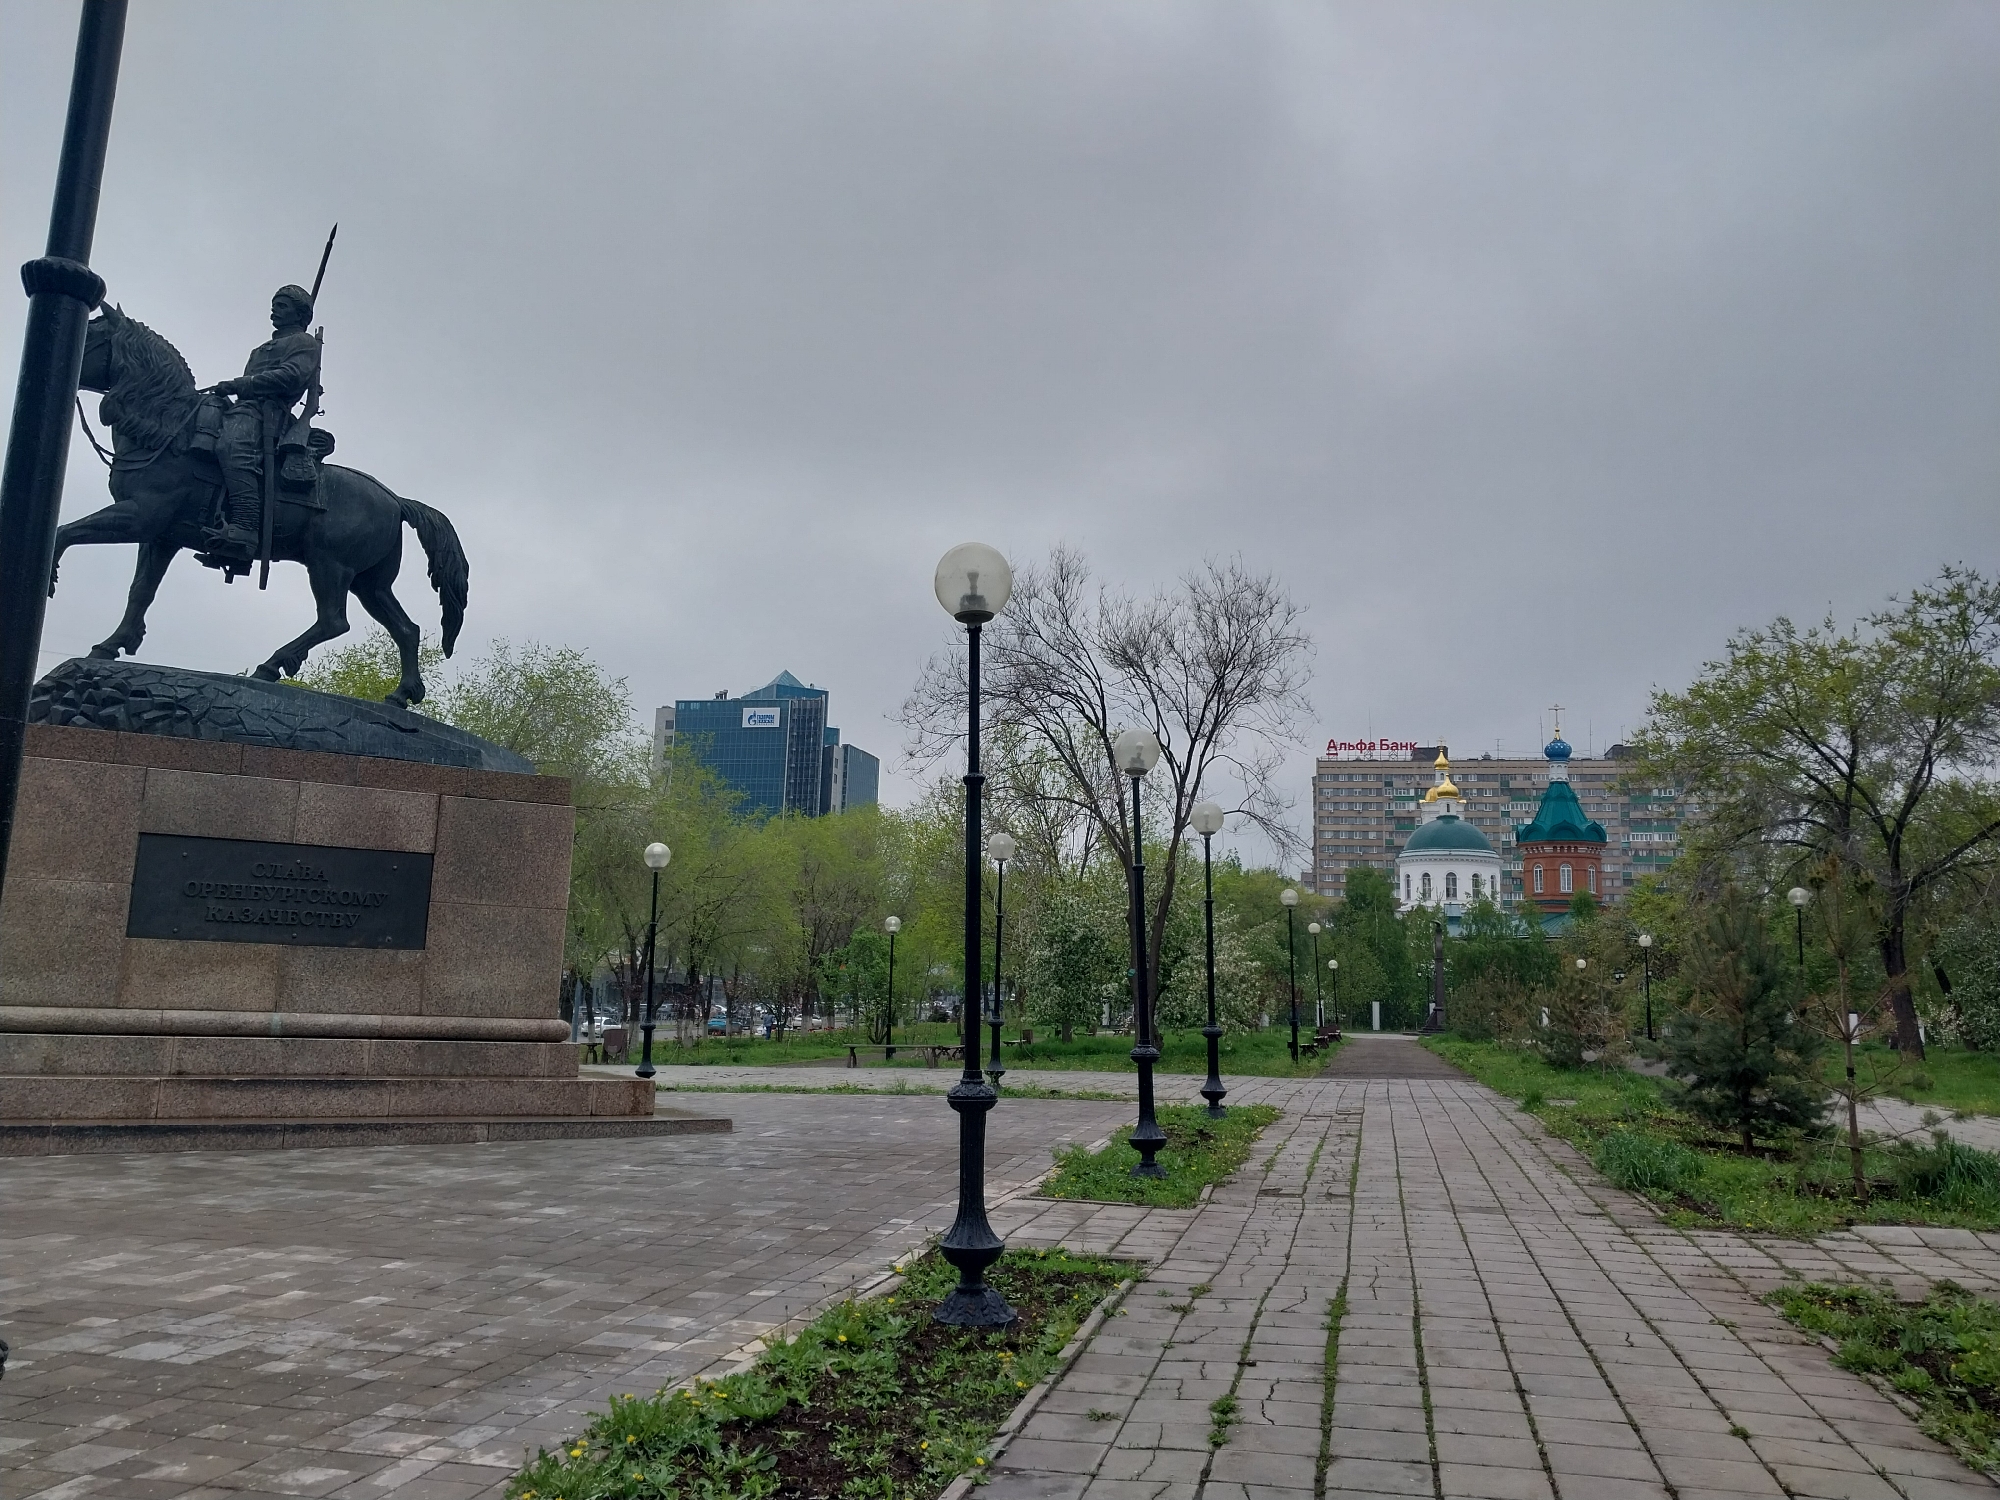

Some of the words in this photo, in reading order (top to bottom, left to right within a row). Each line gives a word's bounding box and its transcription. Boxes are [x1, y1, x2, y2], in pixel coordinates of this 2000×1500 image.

[1326, 738, 1376, 756] Альфа
[1380, 738, 1418, 751] Банк
[251, 862, 329, 882] СЛАВА
[183, 881, 389, 908] ОРЕНБУРГСКОМУ
[205, 905, 361, 928] КАЗАЧЕСТВУ
